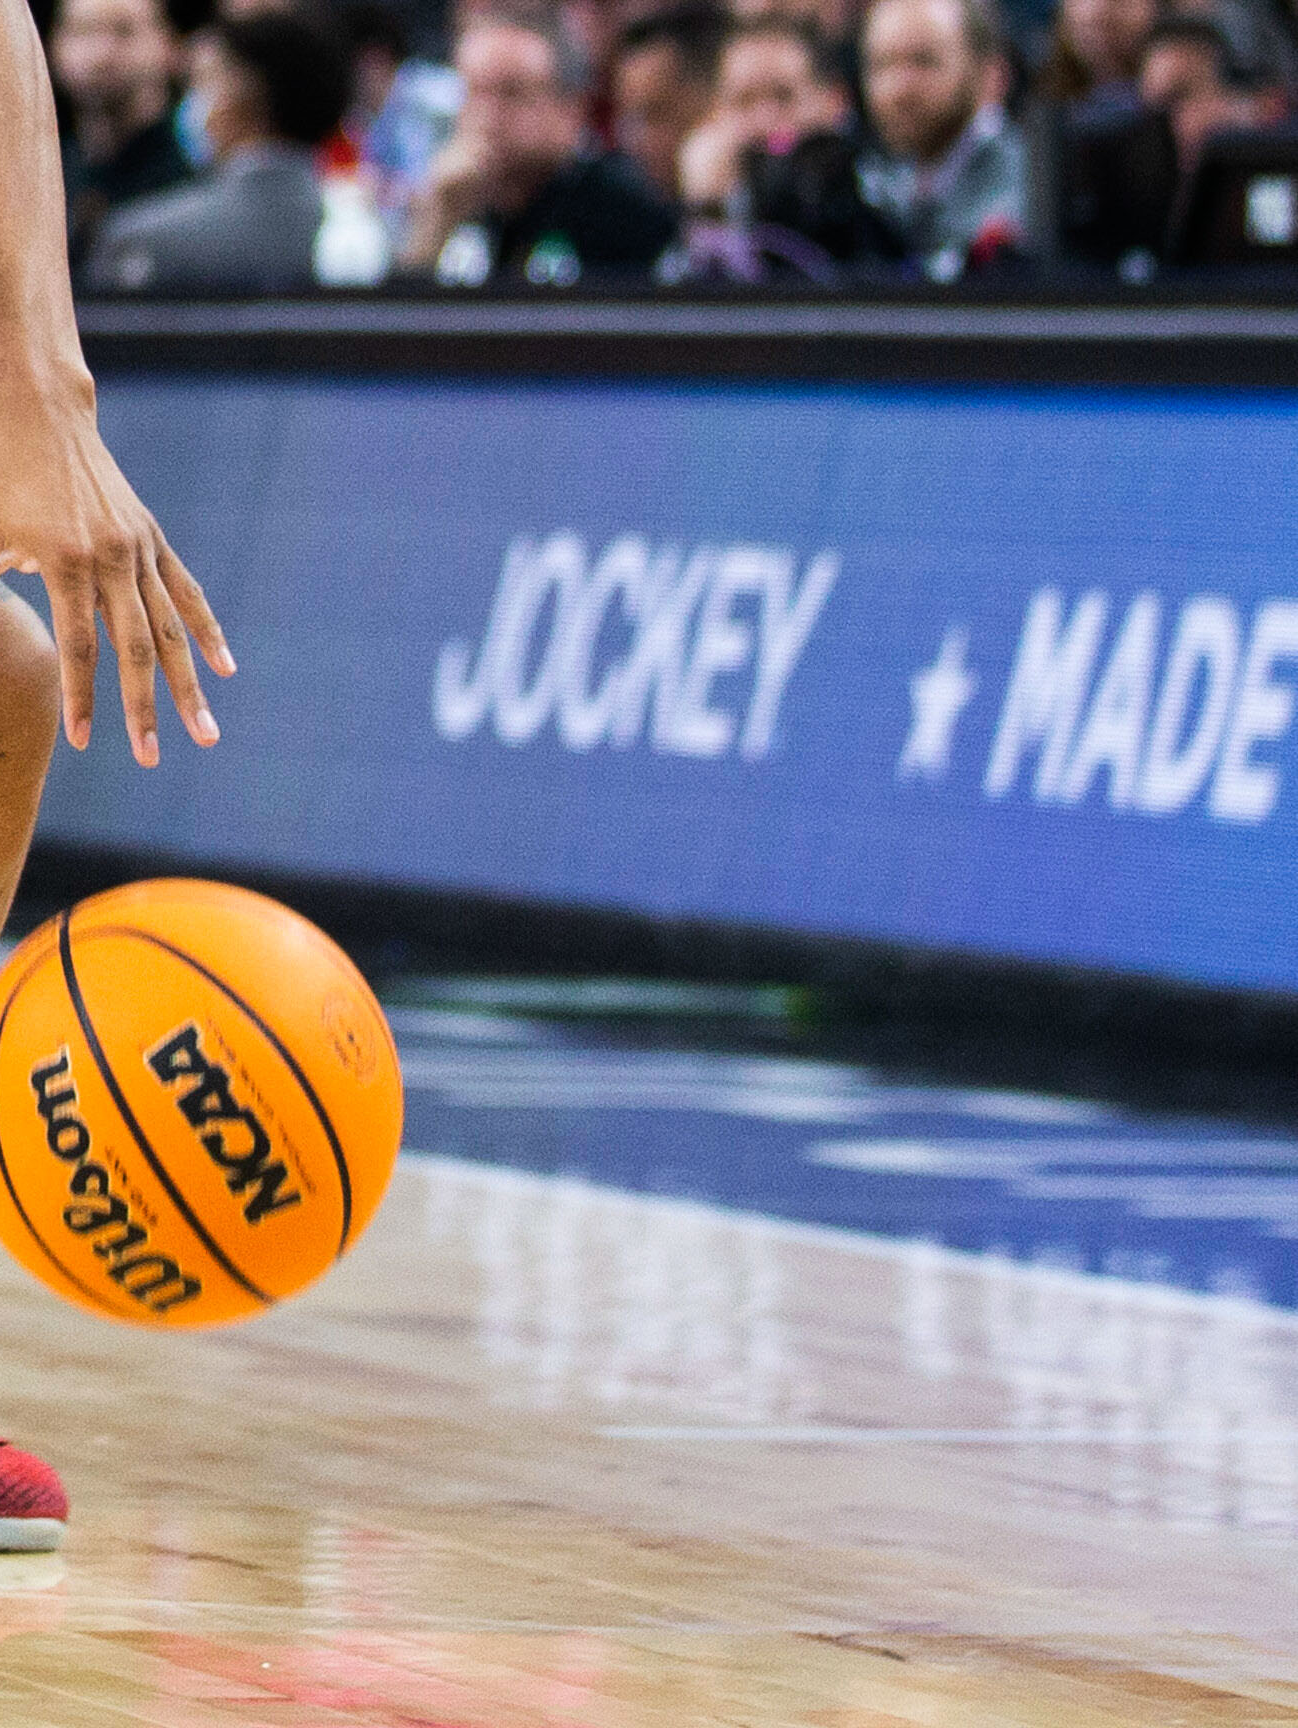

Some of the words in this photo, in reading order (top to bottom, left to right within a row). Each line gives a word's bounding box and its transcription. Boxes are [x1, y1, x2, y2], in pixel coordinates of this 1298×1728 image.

[432, 528, 843, 763] JOCKEY
[983, 586, 1298, 826] MADE
[28, 1042, 203, 1312] Wilson
[143, 1019, 303, 1226] NCAA
